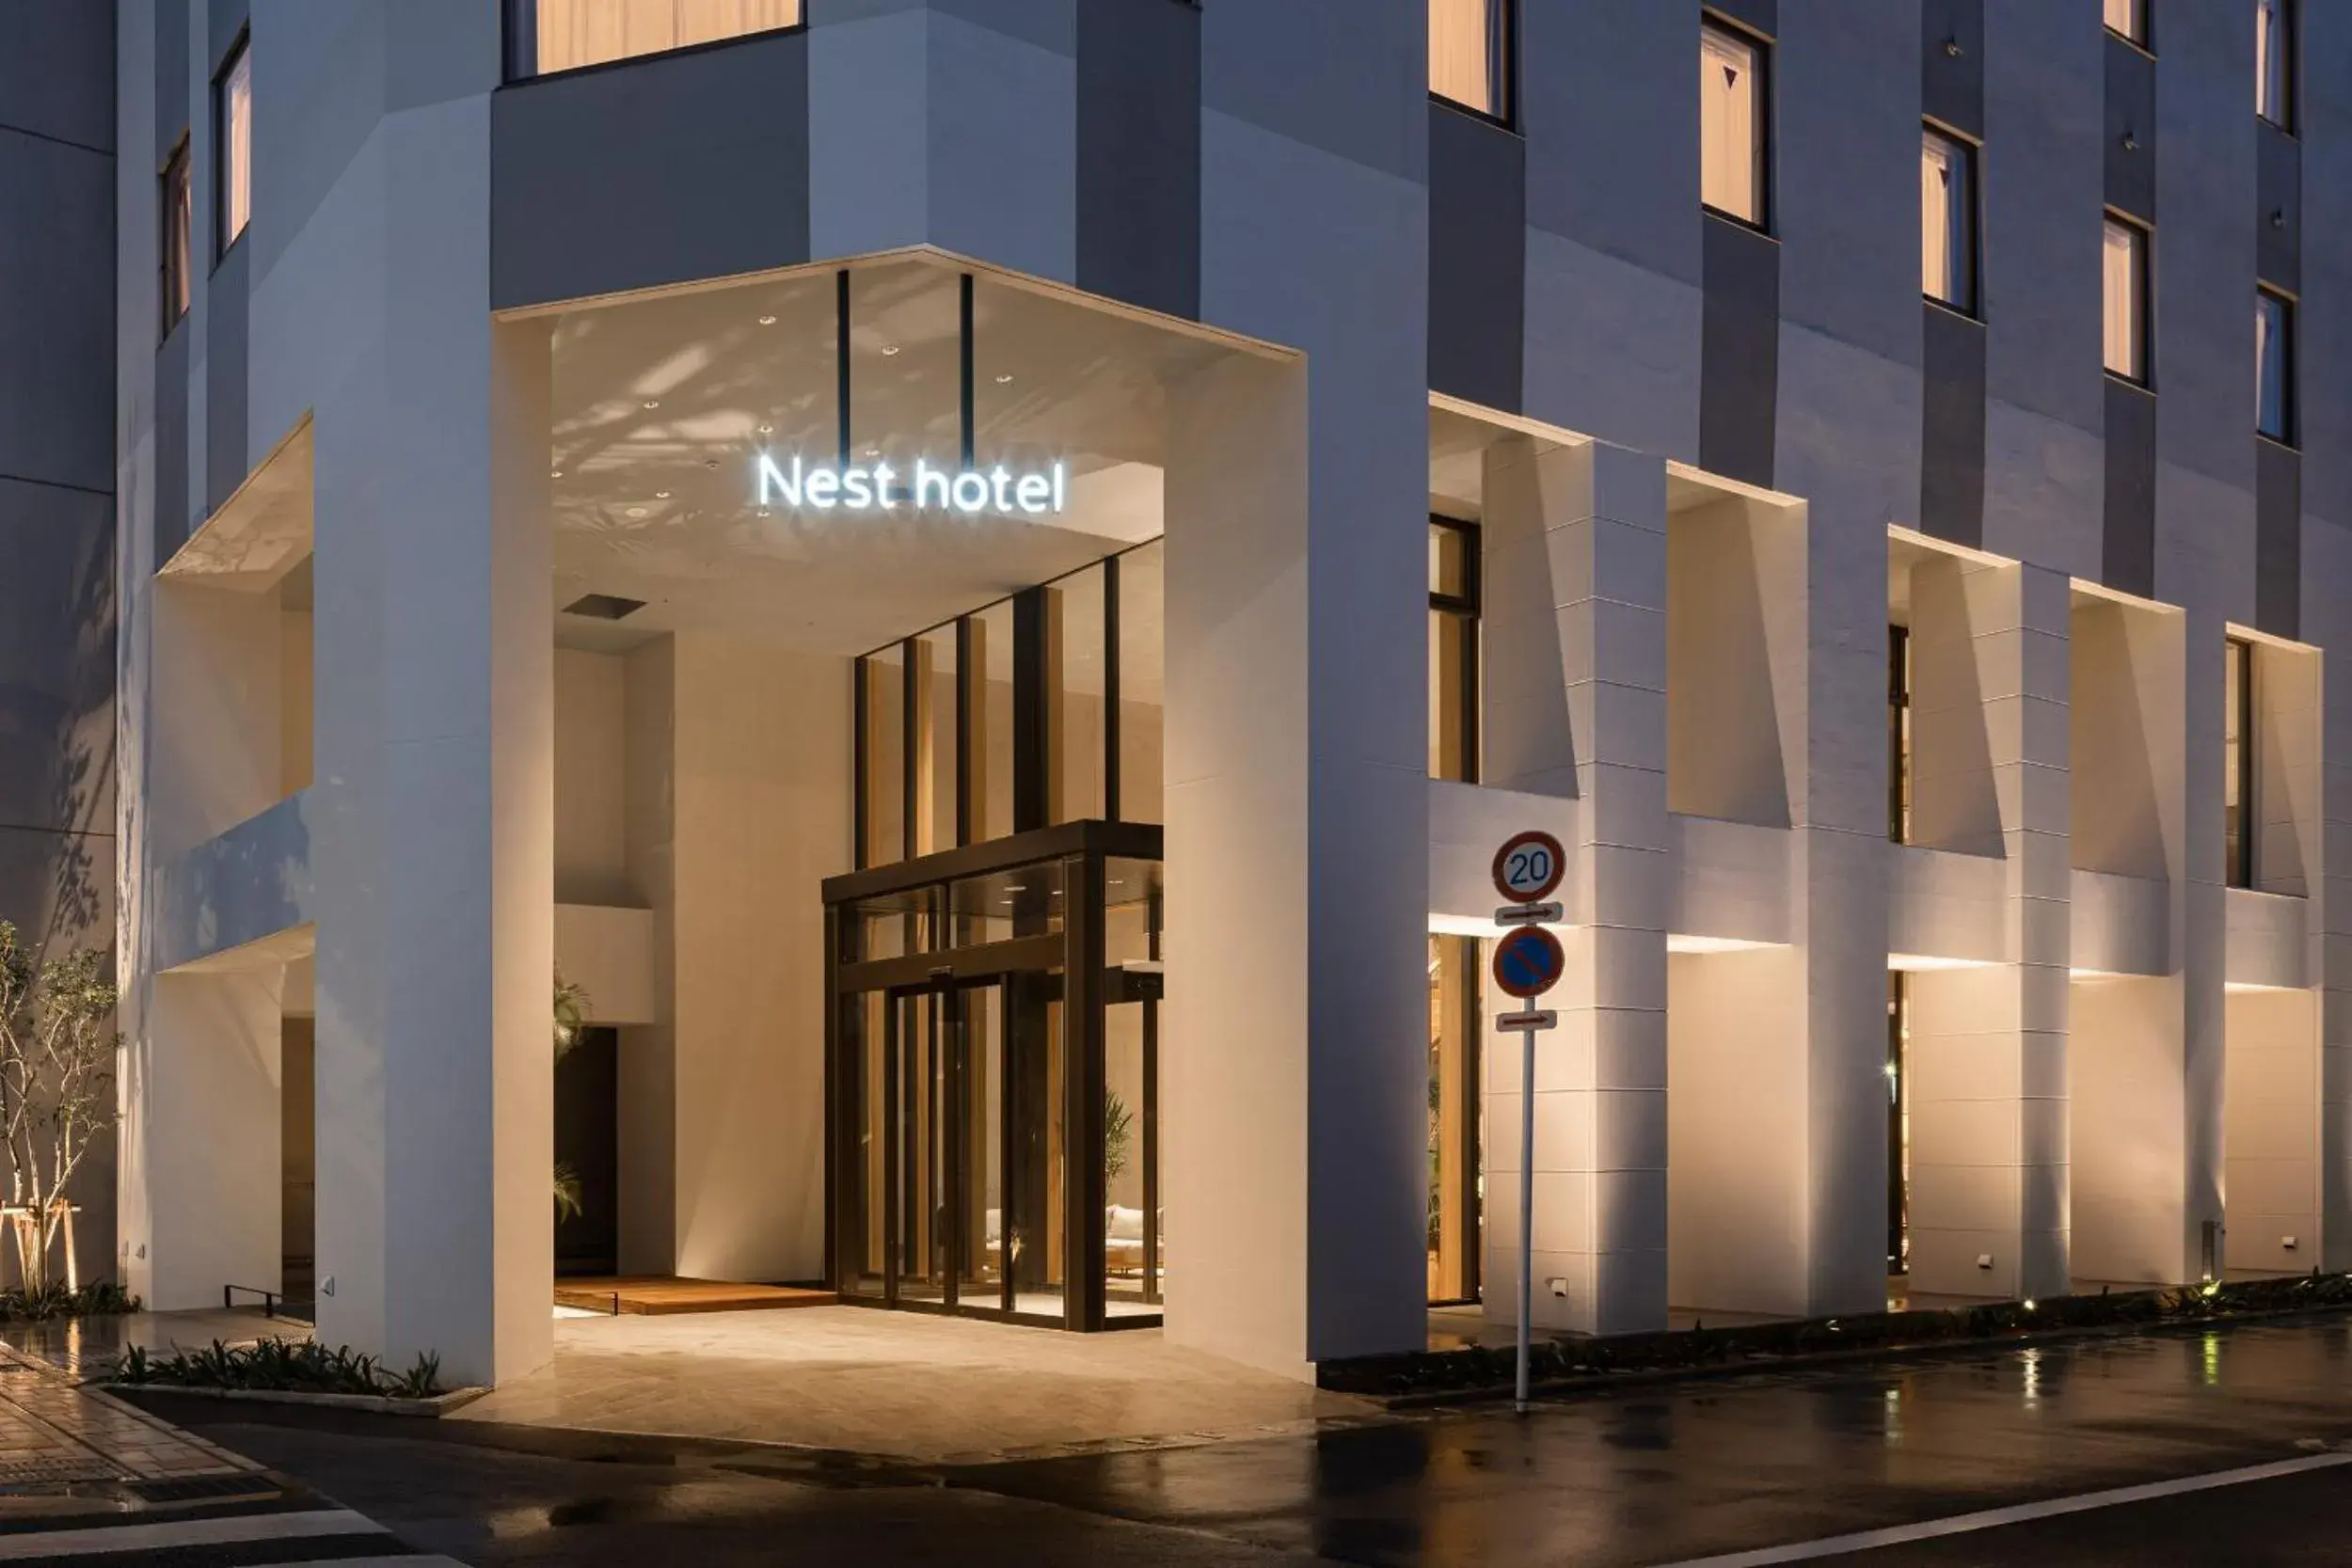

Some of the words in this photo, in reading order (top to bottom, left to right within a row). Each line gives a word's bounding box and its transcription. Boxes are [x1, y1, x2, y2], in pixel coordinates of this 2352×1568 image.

[758, 454, 898, 508] Nest
[915, 458, 1063, 513] hotel
[1509, 850, 1549, 885] 20
